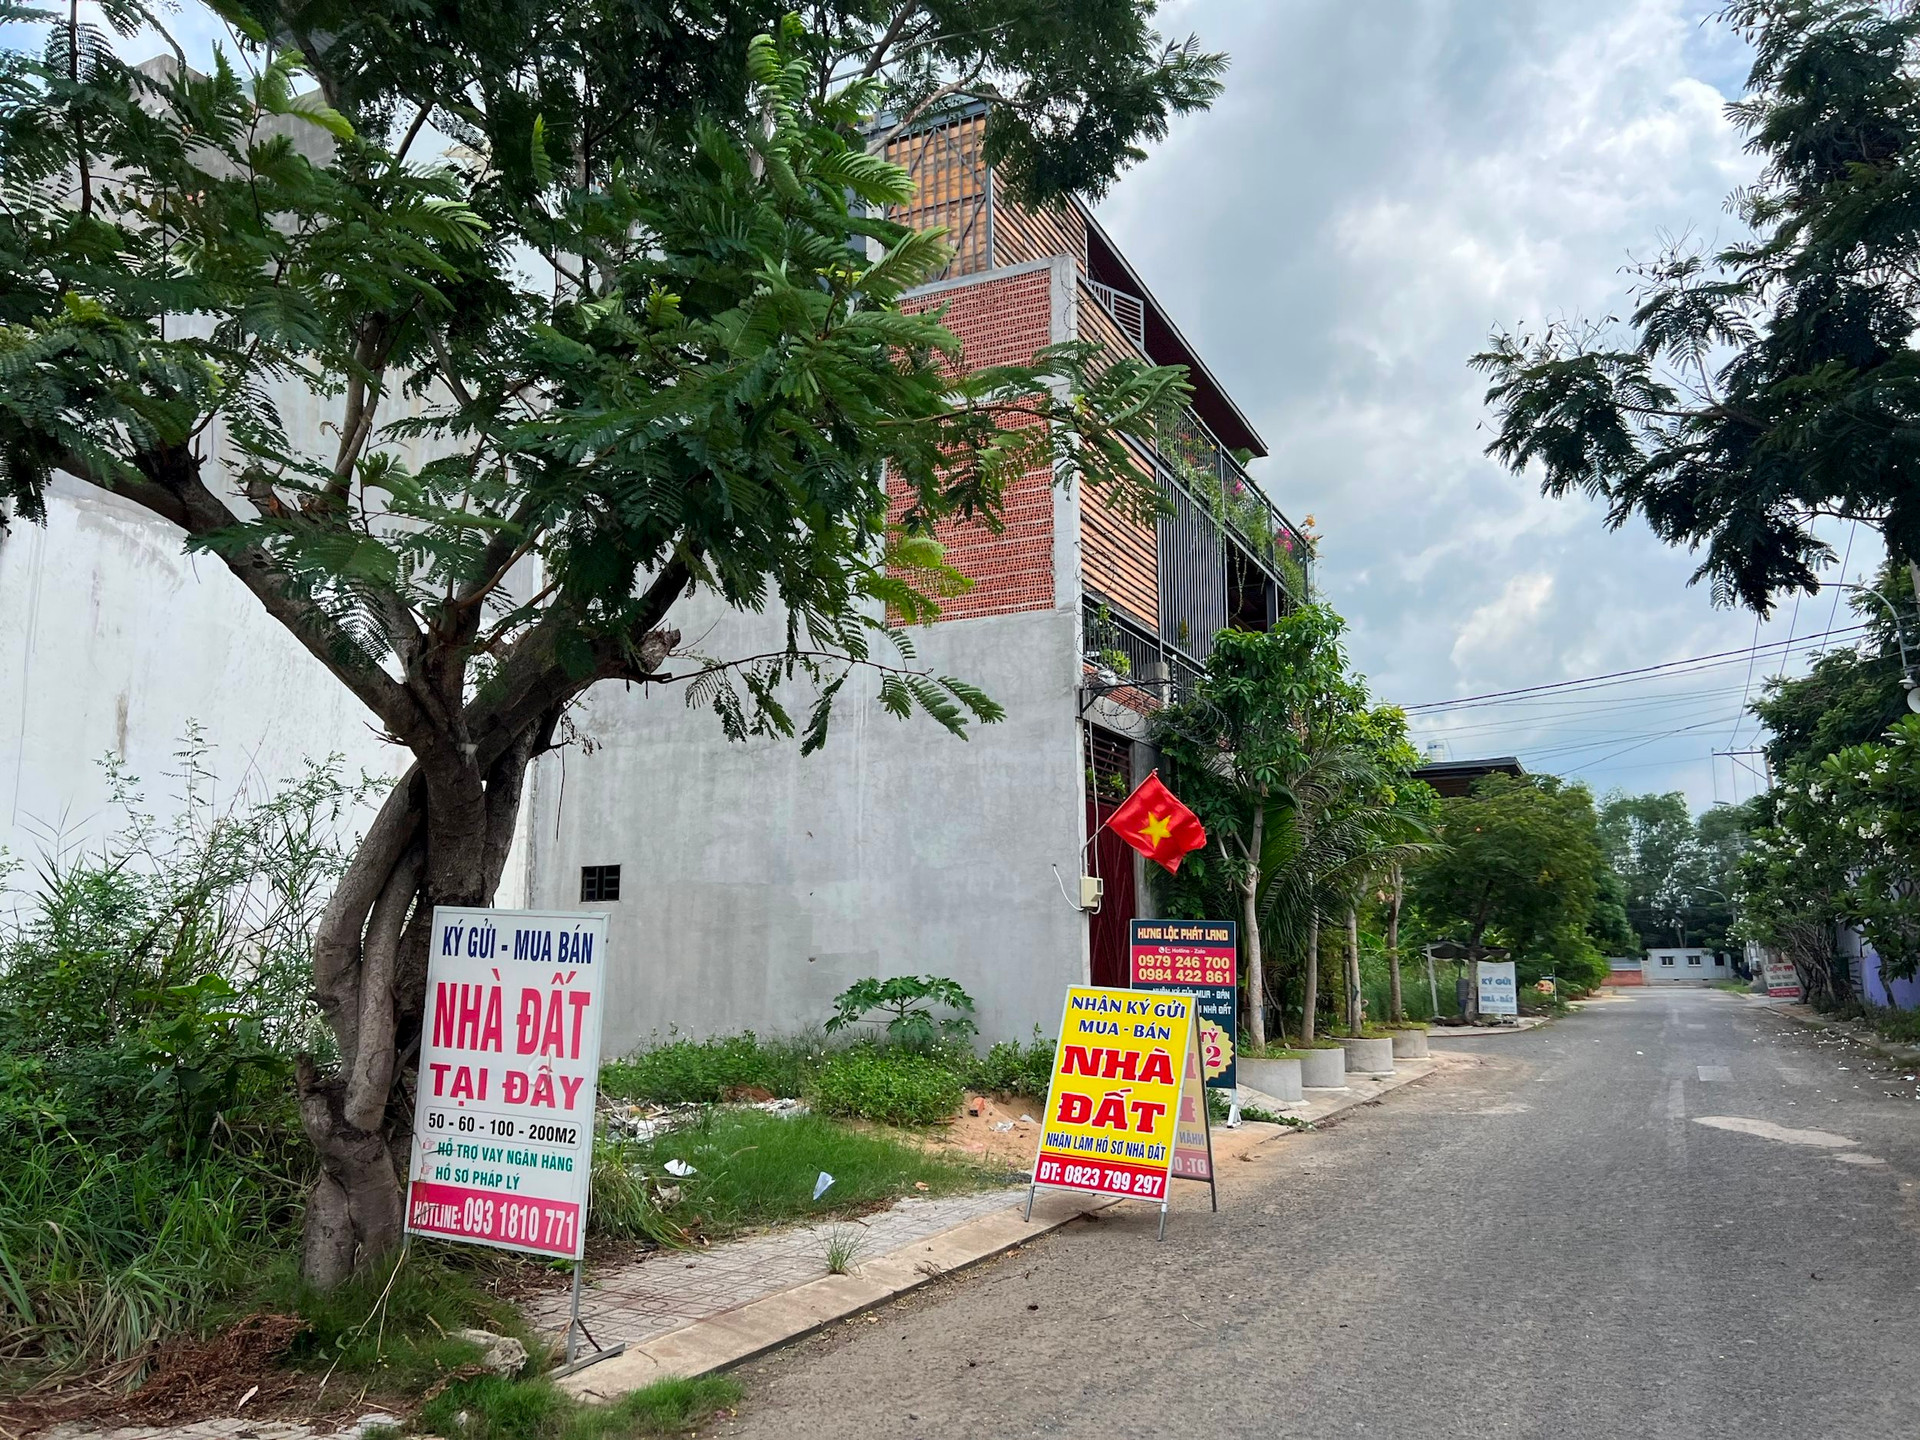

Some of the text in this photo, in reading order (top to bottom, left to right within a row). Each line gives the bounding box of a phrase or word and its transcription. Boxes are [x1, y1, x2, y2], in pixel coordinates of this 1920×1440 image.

[442, 919, 464, 956] KÝ
[468, 918, 496, 959] GỬI
[514, 930, 551, 962] MUA
[558, 924, 593, 964] BÁN
[1138, 925, 1228, 942] HƯNG LỘC PHÁT LAND
[1138, 955, 1230, 969] 0979 246 700
[1139, 968, 1230, 984] 0984 422 861
[1071, 995, 1123, 1013] NHẬN
[1126, 997, 1151, 1015] KÝ
[1154, 1001, 1186, 1019] GỬI
[1216, 989, 1230, 999] BÁN
[432, 968, 591, 1060] NHÀ ĐẤT
[1203, 1003, 1217, 1014] NHÀ
[1079, 1020, 1119, 1036] MUA
[1133, 1022, 1171, 1040] BÁN
[1061, 1045, 1174, 1085] NHÀ
[430, 1063, 585, 1110] TẠI ĐÂY
[1057, 1088, 1166, 1133] ĐẤT
[428, 1113, 444, 1129] 50
[458, 1116, 475, 1132] 60
[490, 1119, 514, 1137] 100
[528, 1124, 576, 1145] 200M2
[457, 1144, 479, 1163] TRỢ
[482, 1147, 503, 1163] VAY
[507, 1148, 537, 1167] NGÂN
[541, 1152, 573, 1172] HÀNG
[1046, 1132, 1071, 1151] NHẬN
[1074, 1135, 1093, 1152] LÀM
[1111, 1140, 1124, 1155] SƠ
[1126, 1140, 1145, 1159] NHÀ
[1148, 1140, 1166, 1161] ĐẤT
[454, 1168, 469, 1183] SƠ
[472, 1169, 503, 1188] PHÁP
[506, 1172, 520, 1190] LÝ
[1040, 1161, 1163, 1195] ĐT: 0823 799 297
[463, 1197, 494, 1235] 093
[500, 1201, 539, 1242] 1810
[545, 1209, 575, 1249] 771
